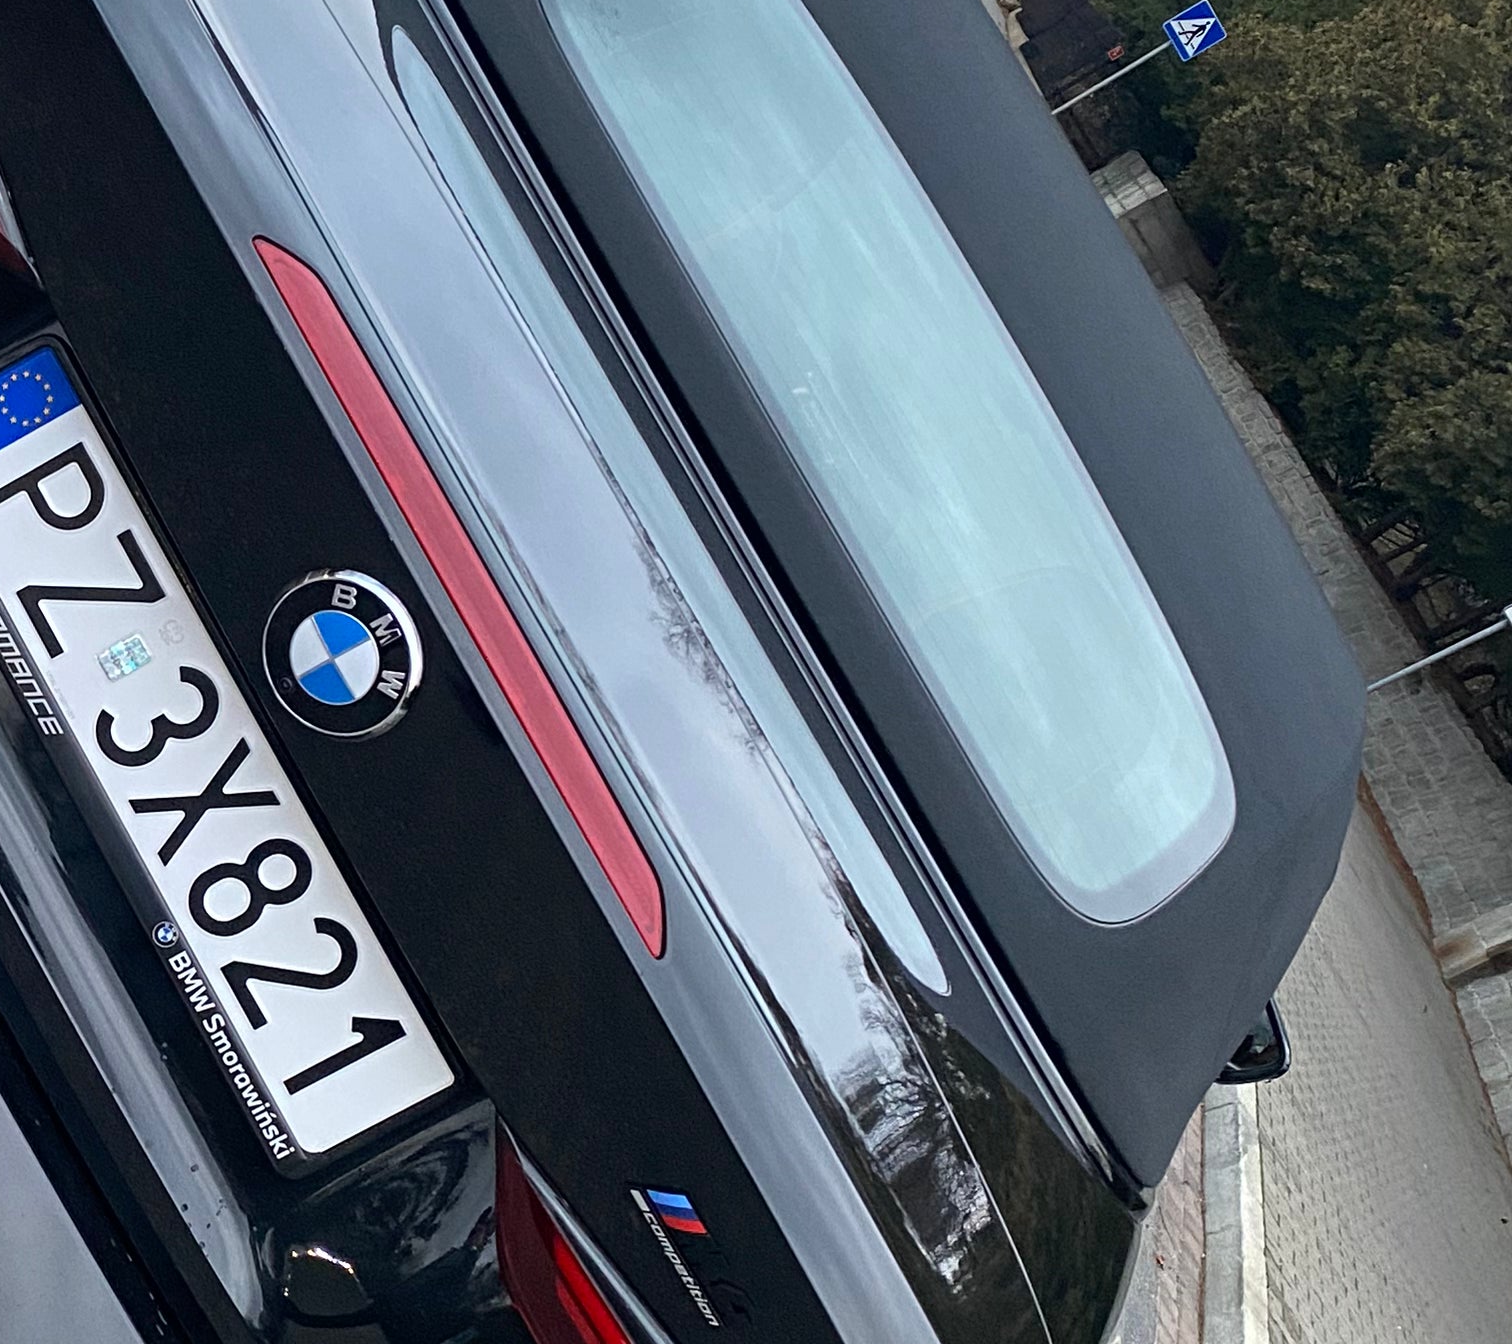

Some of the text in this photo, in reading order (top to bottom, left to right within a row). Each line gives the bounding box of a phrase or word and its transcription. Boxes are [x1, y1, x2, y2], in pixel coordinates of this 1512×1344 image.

[330, 583, 406, 700] BMW
[94, 665, 408, 1097] 3X821
[168, 950, 295, 1161] BMW Smorawiński
[642, 1211, 719, 1326] competition
